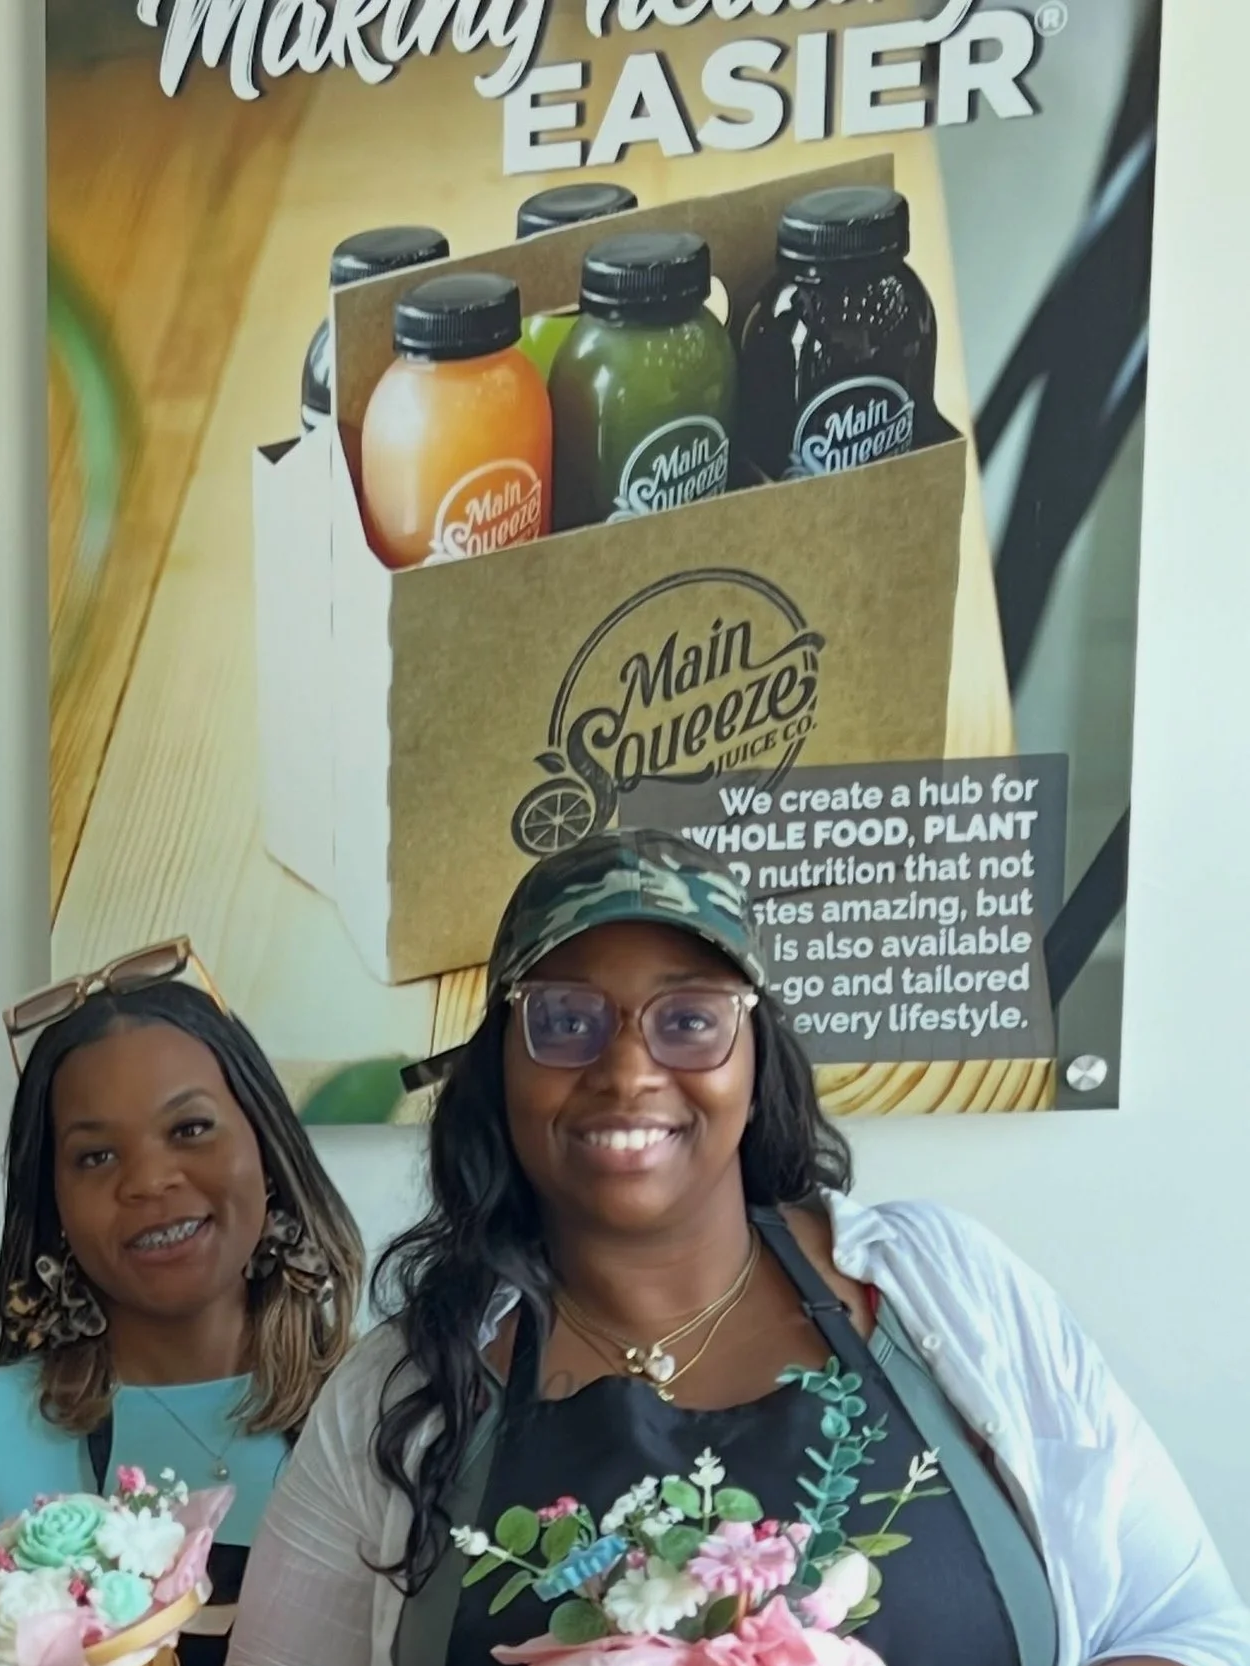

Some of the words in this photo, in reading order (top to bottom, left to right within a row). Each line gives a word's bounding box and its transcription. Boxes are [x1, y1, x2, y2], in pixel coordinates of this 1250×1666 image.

[137, 0, 545, 100] Making
[825, 398, 889, 442] Main
[652, 436, 710, 482] Main
[465, 479, 521, 526] Main
[620, 617, 753, 709] Main
[566, 662, 818, 820] Squeeze
[715, 728, 779, 779] JUICE
[782, 715, 817, 742] CO.
[718, 786, 773, 816] We
[779, 781, 882, 813] create
[891, 784, 910, 808] a
[918, 774, 982, 806] hub
[991, 773, 1039, 803] for
[681, 822, 806, 853] WHOLE
[813, 817, 915, 849] FOOD,
[925, 811, 1037, 843] PLANT
[759, 856, 895, 889] nutrition
[904, 852, 971, 883] that
[979, 850, 1035, 879] not
[821, 891, 968, 925] amazing,
[976, 889, 1034, 917] but
[774, 933, 799, 962] is
[806, 931, 874, 960] also
[881, 924, 1032, 958] available
[831, 966, 893, 997] and
[901, 963, 1030, 994] tailored
[793, 1009, 882, 1040] every
[888, 1001, 1029, 1037] lifestyle.
